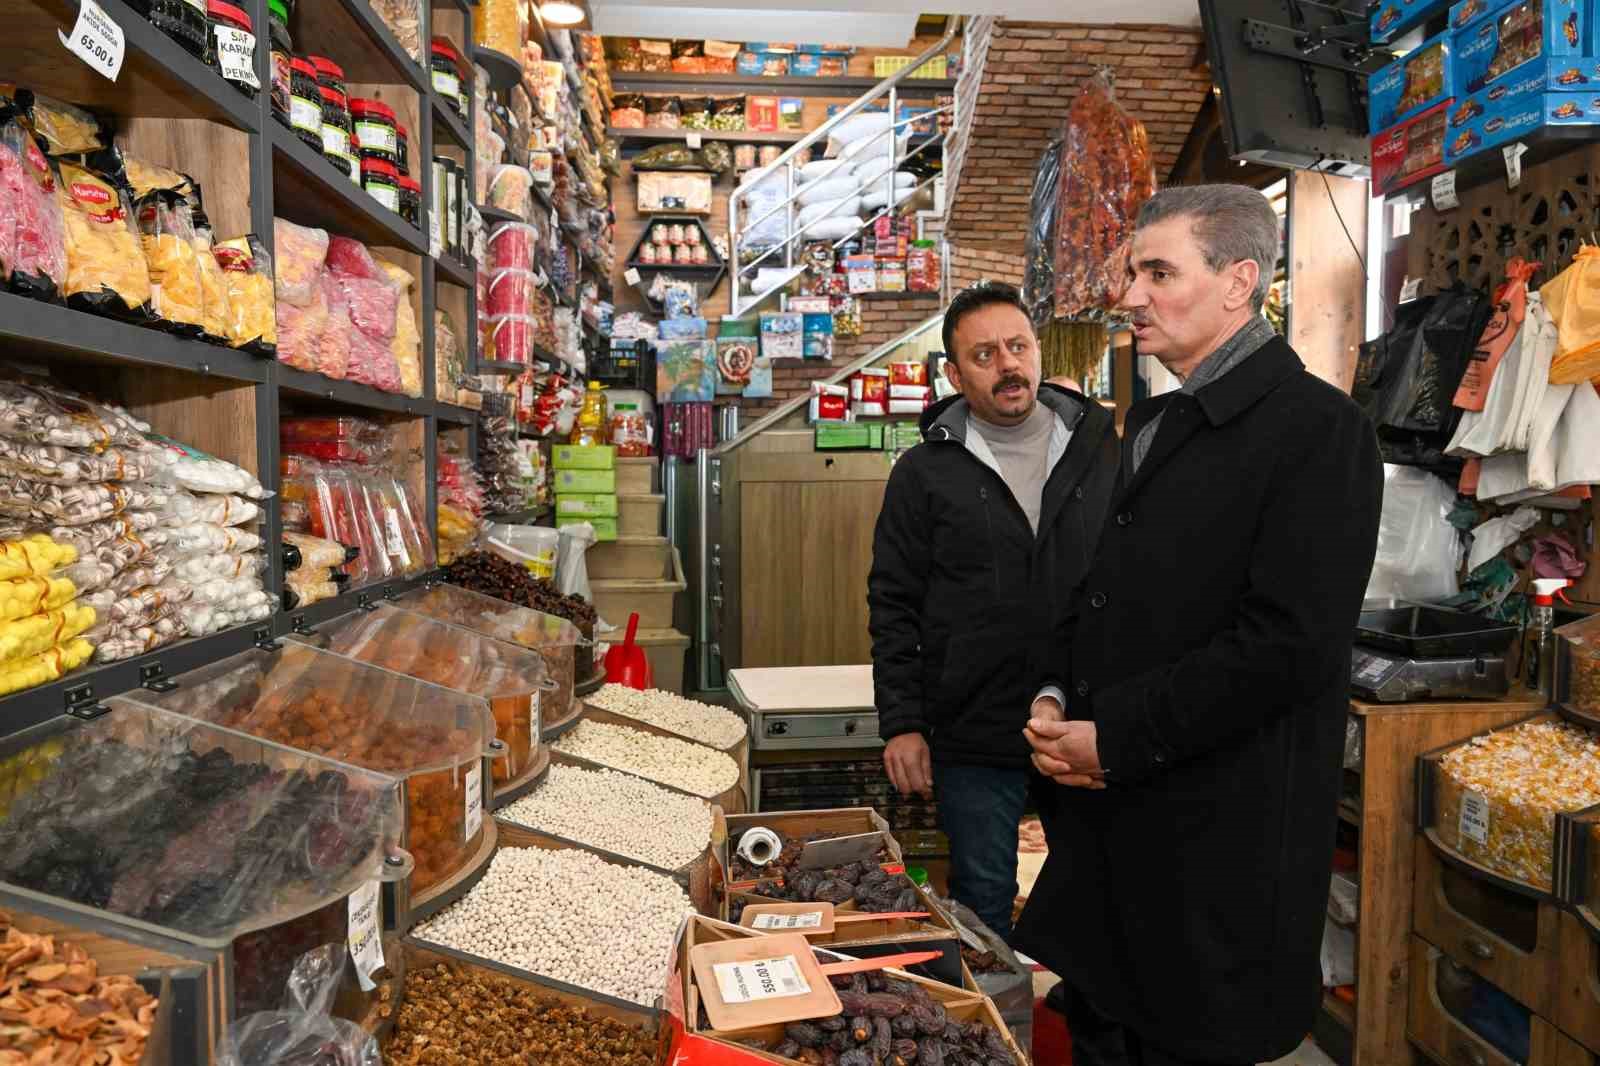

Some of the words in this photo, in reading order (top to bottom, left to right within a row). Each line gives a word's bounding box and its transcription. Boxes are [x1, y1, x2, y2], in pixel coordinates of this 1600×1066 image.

[80, 35, 107, 61] 65.00
[231, 31, 248, 43] SAF
[756, 968, 777, 993] 550.00
